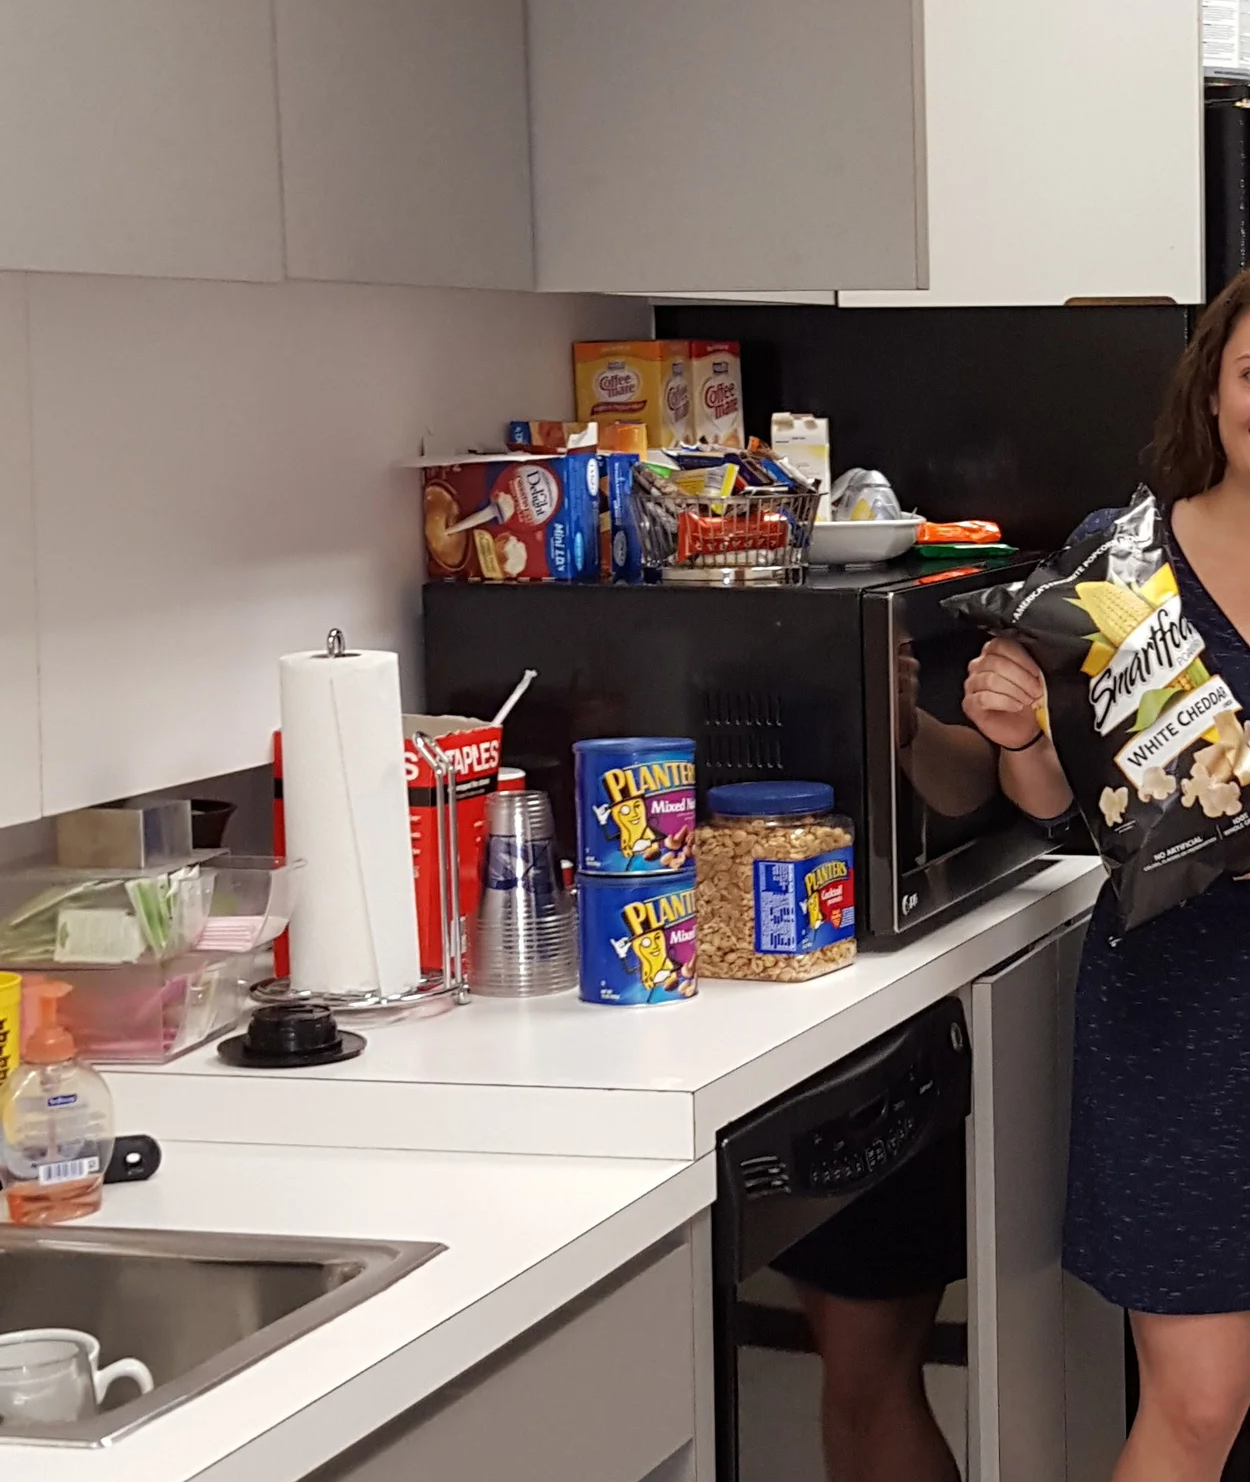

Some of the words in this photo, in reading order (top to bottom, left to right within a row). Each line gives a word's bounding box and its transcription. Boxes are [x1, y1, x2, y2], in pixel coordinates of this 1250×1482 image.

[600, 374, 632, 392] Coffee
[608, 383, 637, 399] mate
[705, 383, 735, 406] Coffee
[714, 398, 739, 420] mate
[527, 470, 549, 517] Delight
[1127, 722, 1180, 768] WHITE
[438, 740, 500, 777] TAPLES
[651, 797, 686, 815] Mixed
[1153, 851, 1166, 861] NO
[1165, 836, 1203, 856] ARTIFICIAL
[805, 861, 848, 898] PLANTERS
